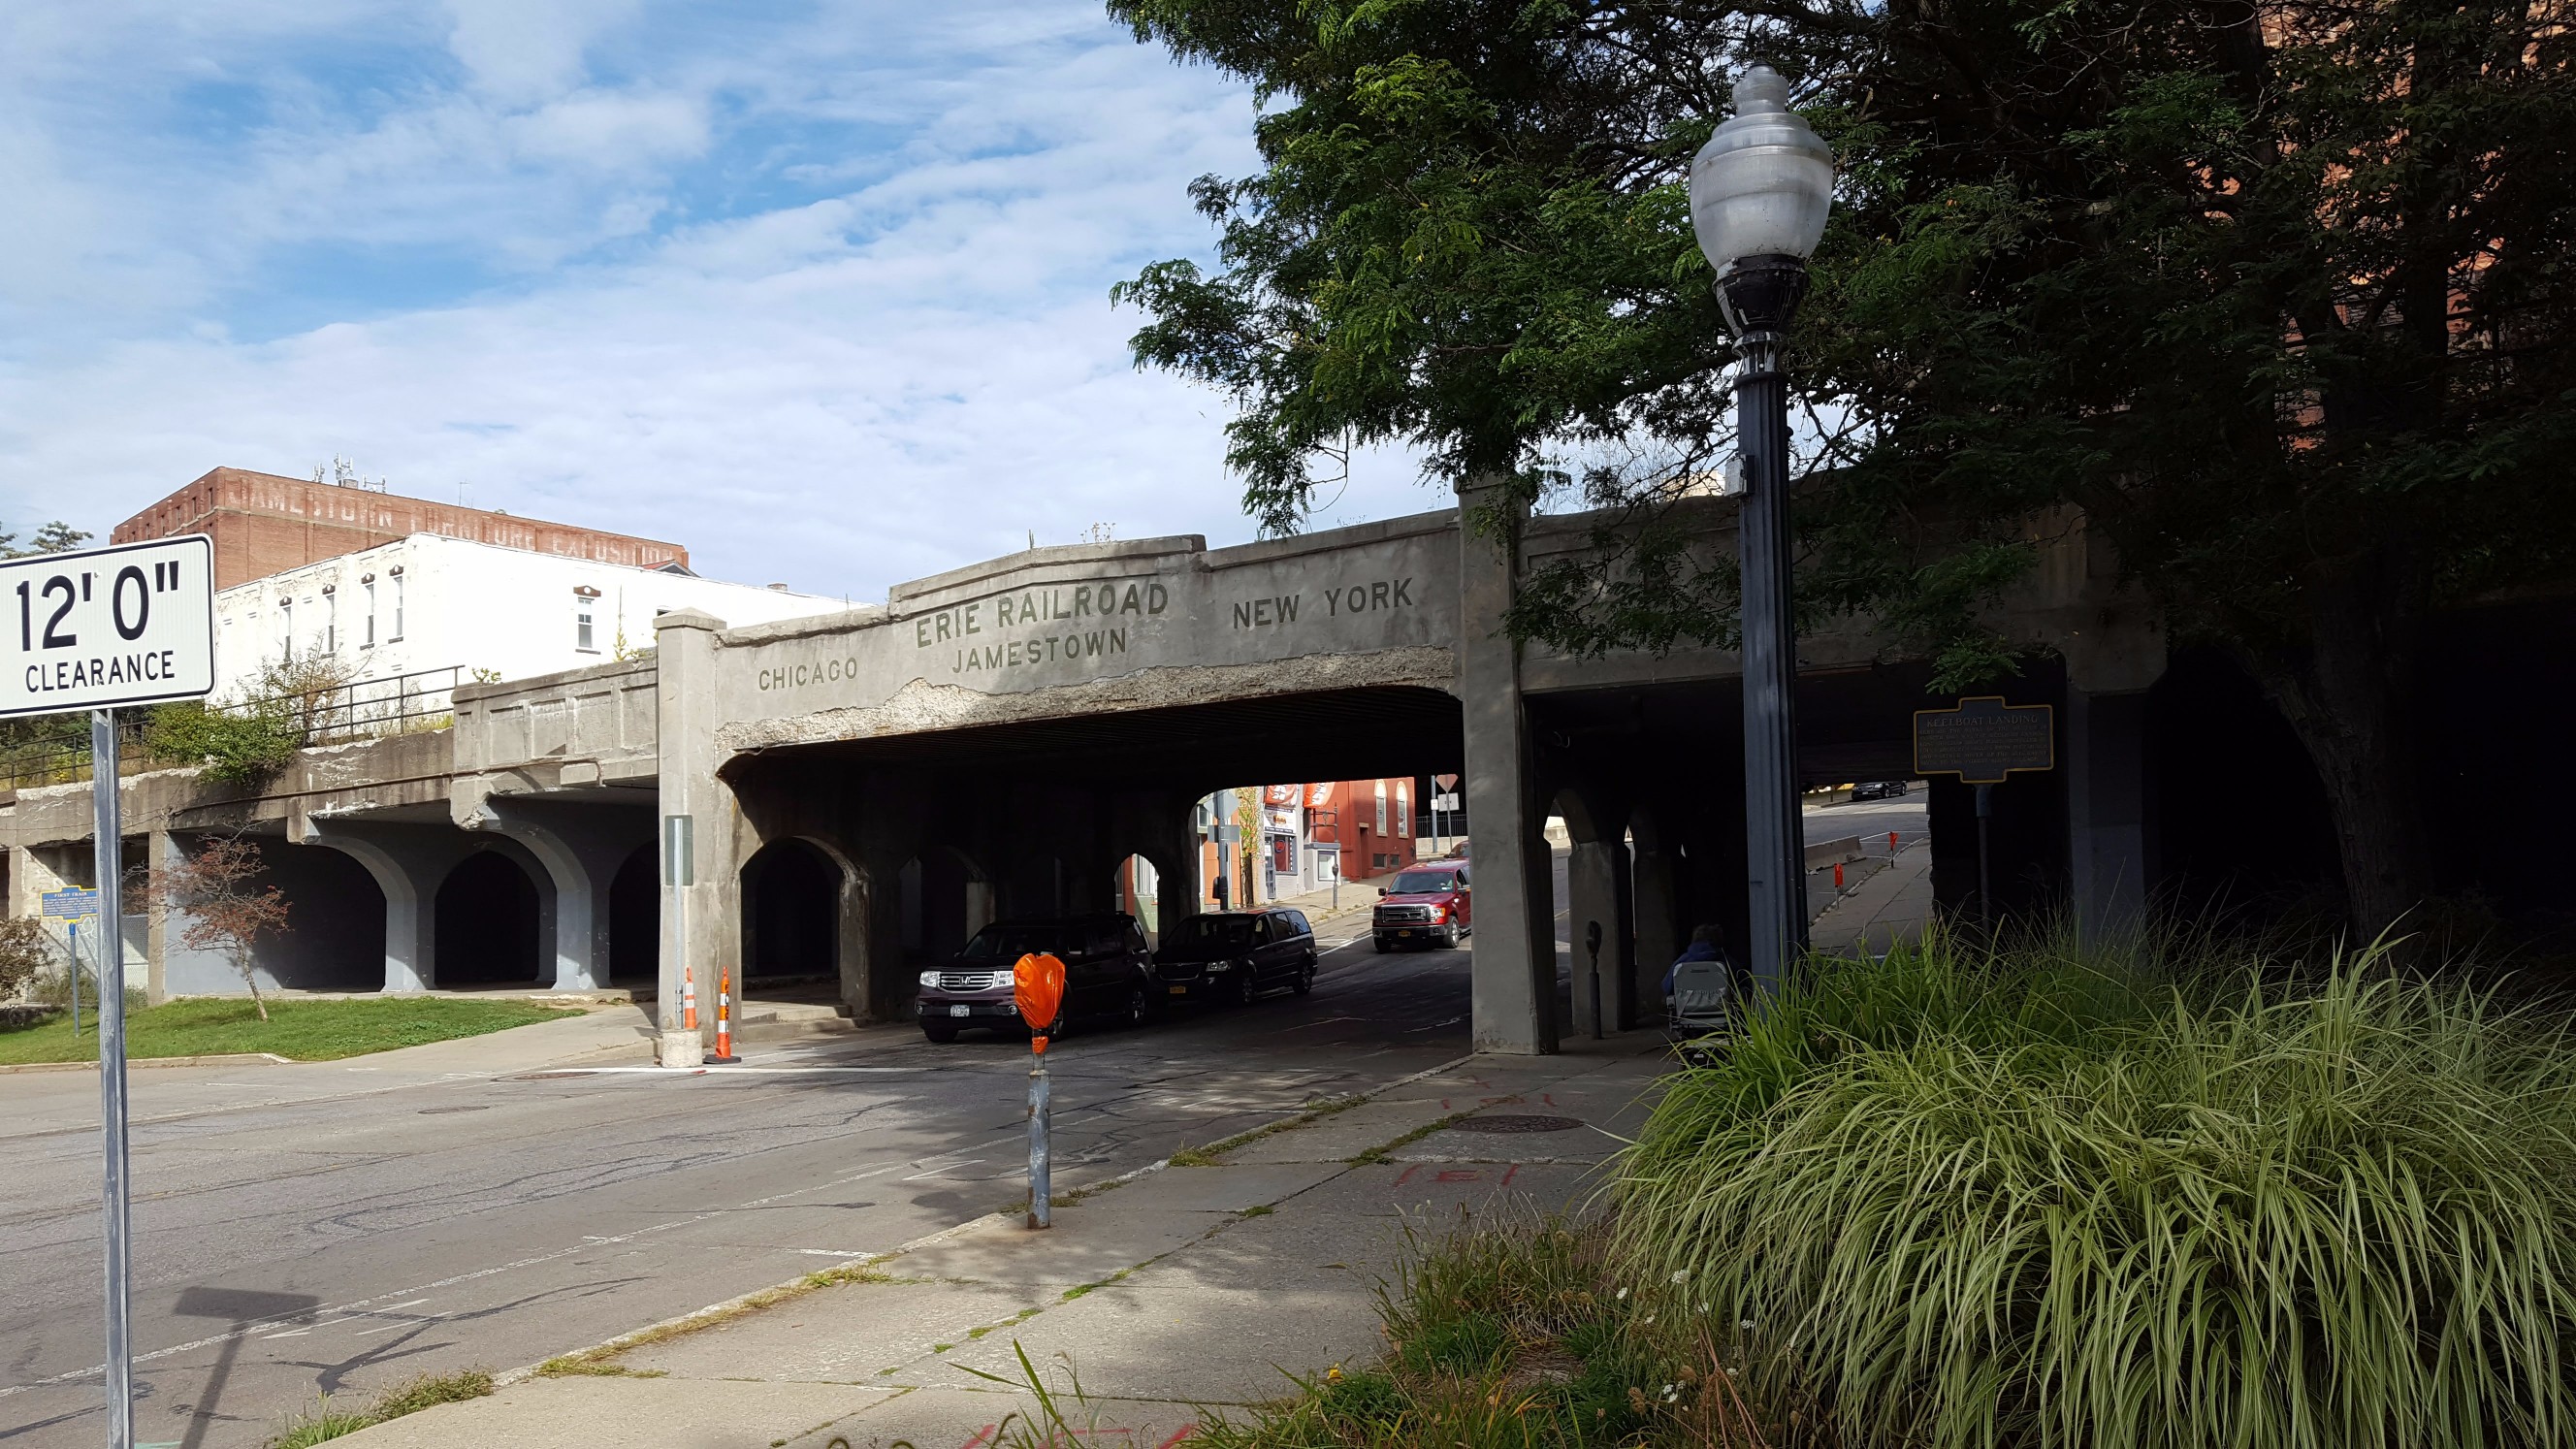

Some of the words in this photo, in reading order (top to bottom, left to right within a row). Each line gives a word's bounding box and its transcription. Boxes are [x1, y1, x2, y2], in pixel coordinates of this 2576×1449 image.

[917, 603, 981, 649] ERIE
[998, 583, 1169, 628] RAILROAD
[1233, 595, 1300, 628] NEW
[1325, 577, 1412, 616] YORK
[25, 650, 176, 693] CLEARANCE
[951, 628, 1127, 673] JAMESTOWN
[758, 657, 858, 692] CHICAGO
[1926, 716, 1984, 727] KEELBOAT
[1988, 714, 2038, 725] LANDING
